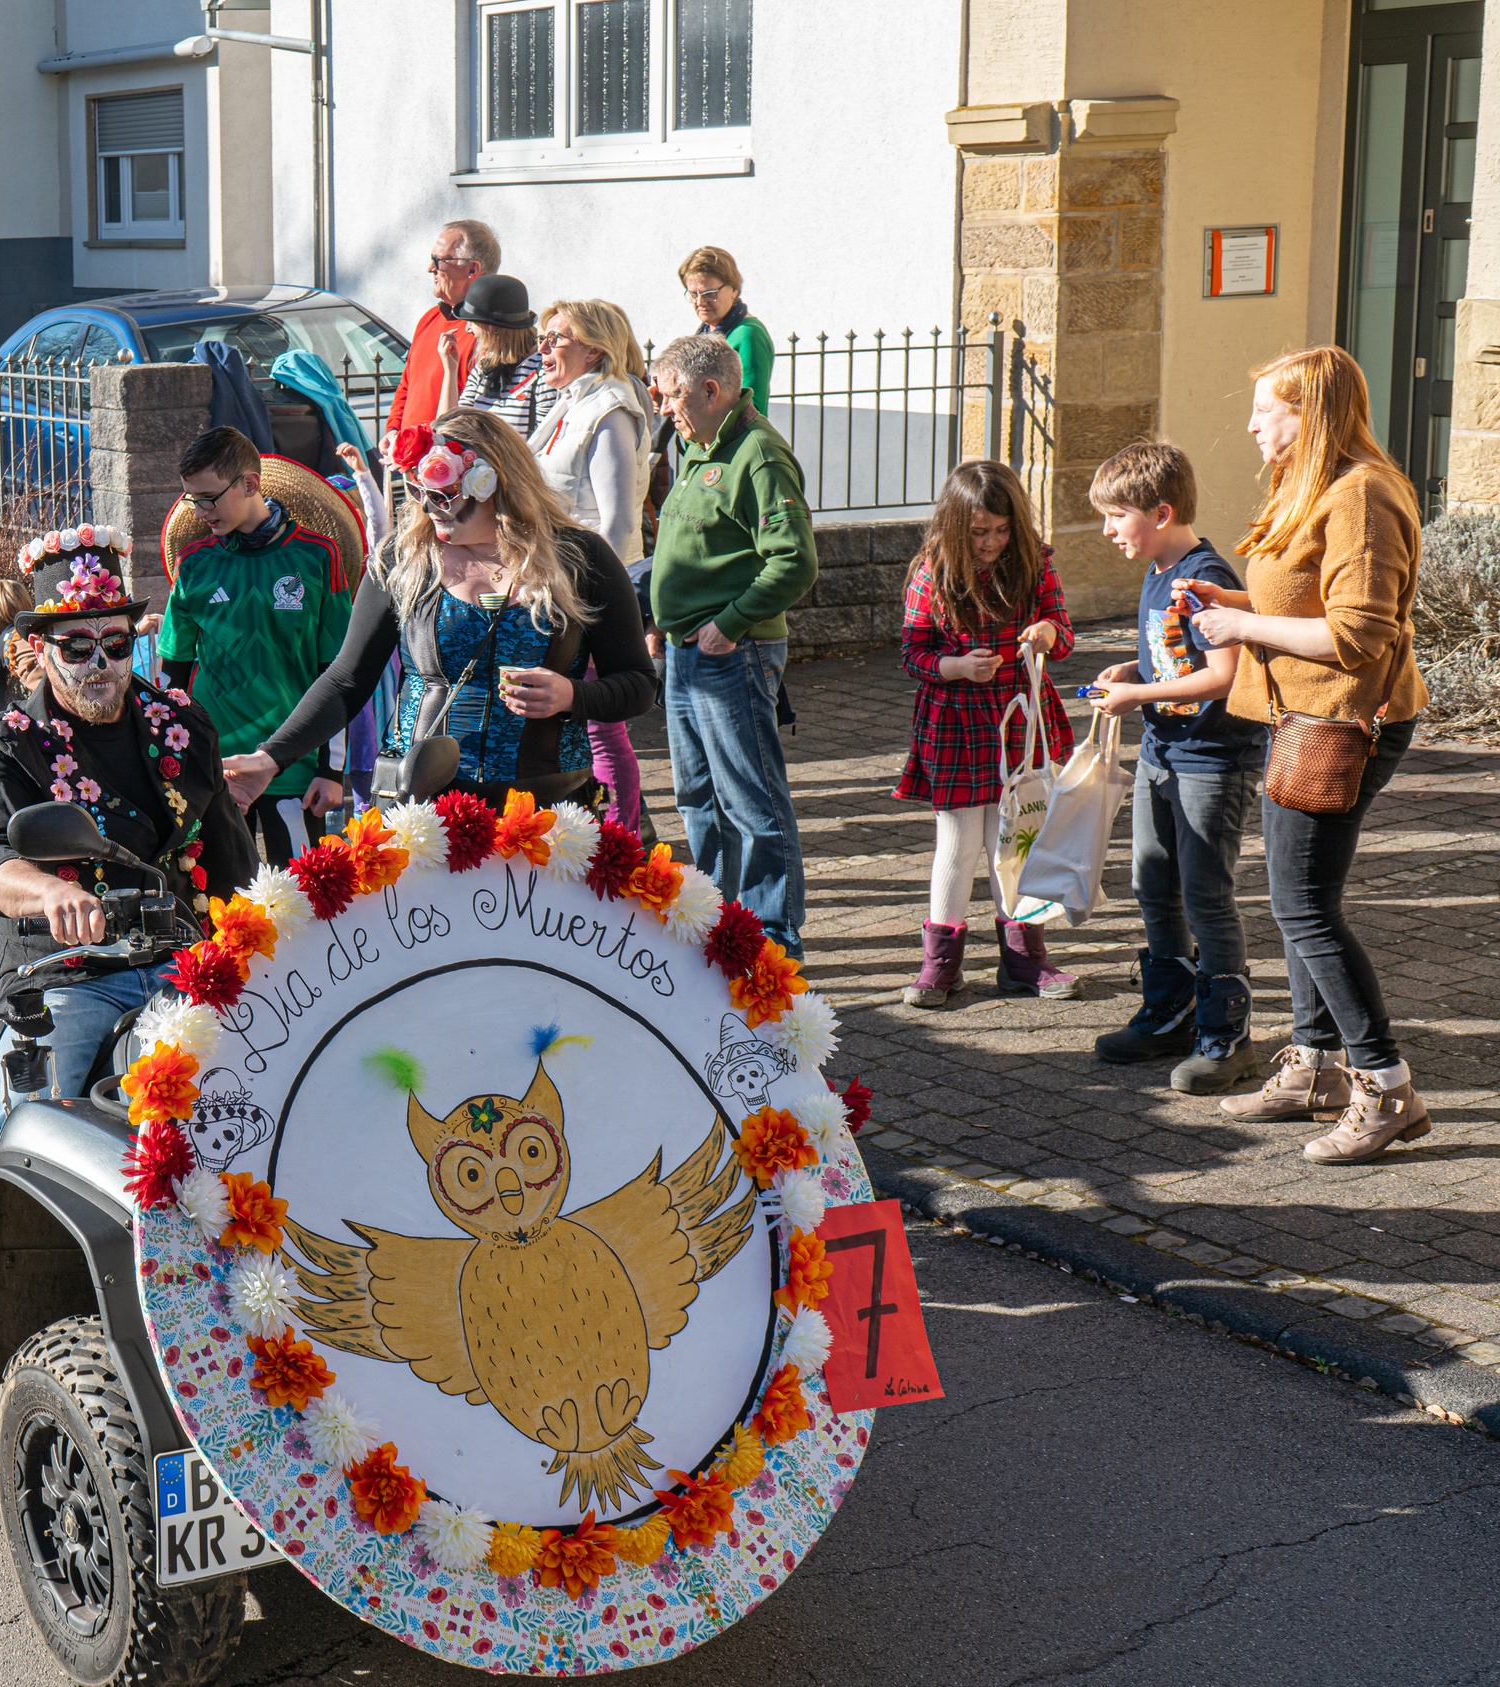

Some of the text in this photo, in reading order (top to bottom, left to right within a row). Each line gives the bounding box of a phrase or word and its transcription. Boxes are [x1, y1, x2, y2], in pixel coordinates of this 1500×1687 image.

[327, 918, 380, 986] de
[384, 885, 451, 949] los
[473, 863, 675, 997] Muertos
[825, 1228, 899, 1379] 7
[167, 1492, 178, 1508] D
[191, 1459, 229, 1511] B
[167, 1514, 272, 1576] KR 3
